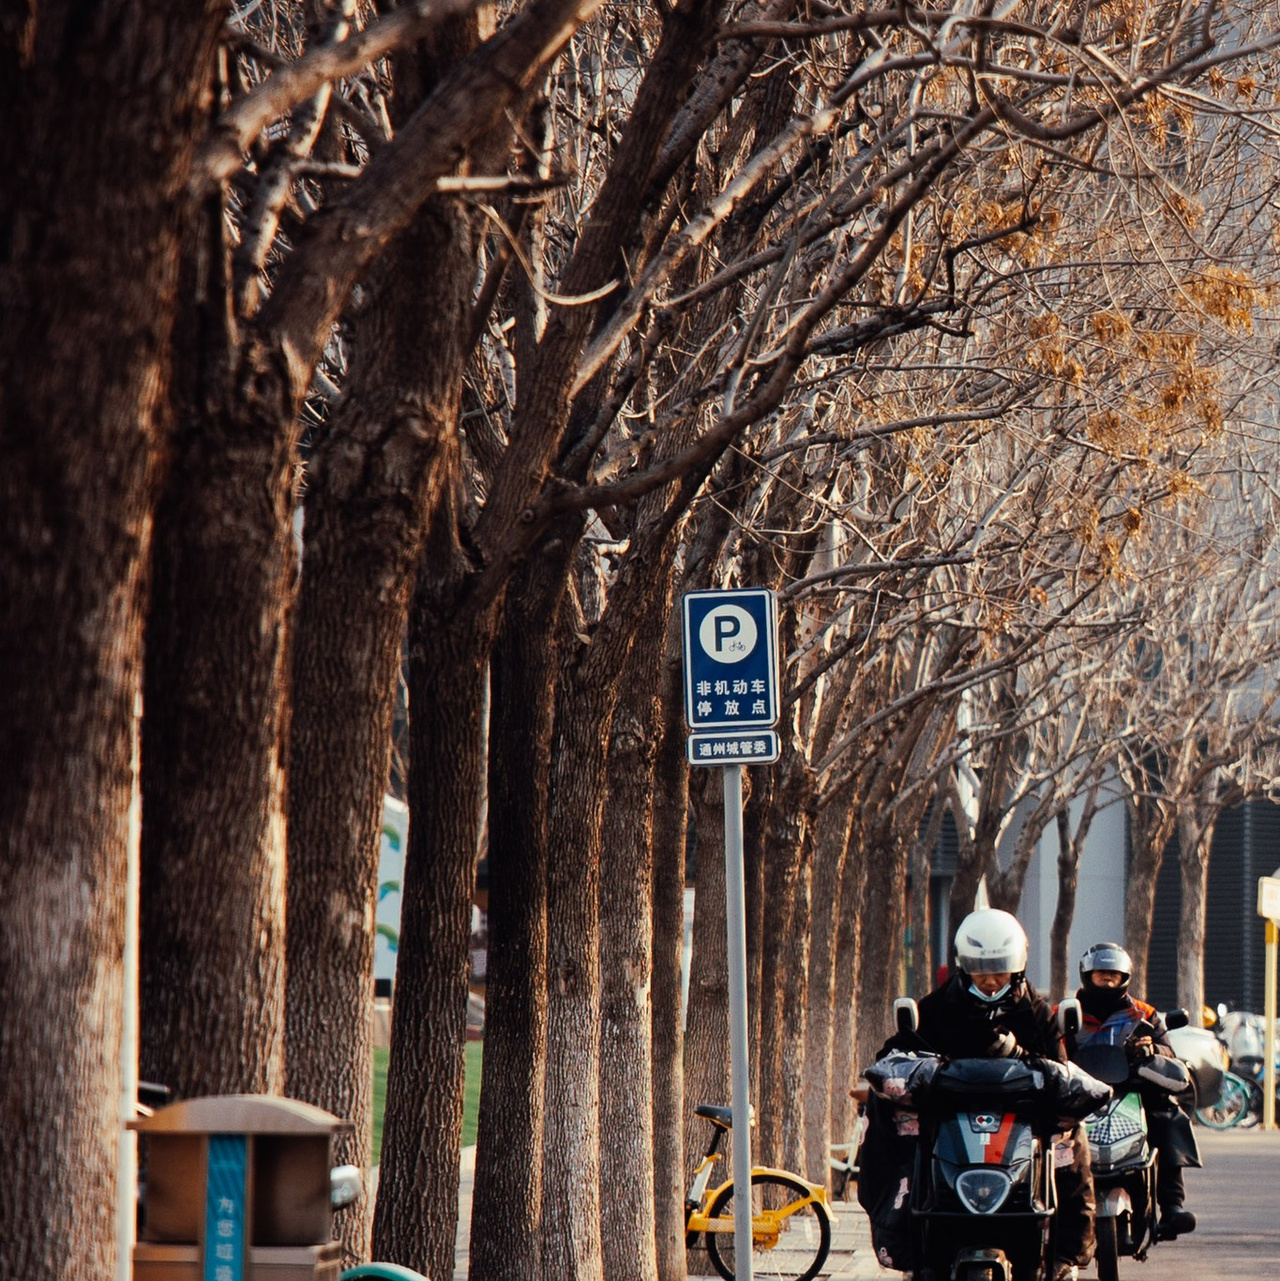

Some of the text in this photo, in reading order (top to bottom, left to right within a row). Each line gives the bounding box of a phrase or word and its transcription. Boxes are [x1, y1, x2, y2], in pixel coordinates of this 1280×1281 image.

[714, 615, 740, 651] P
[696, 679, 766, 696] 非机动车
[697, 699, 766, 717] 停放点
[699, 740, 767, 756] 通州城管委
